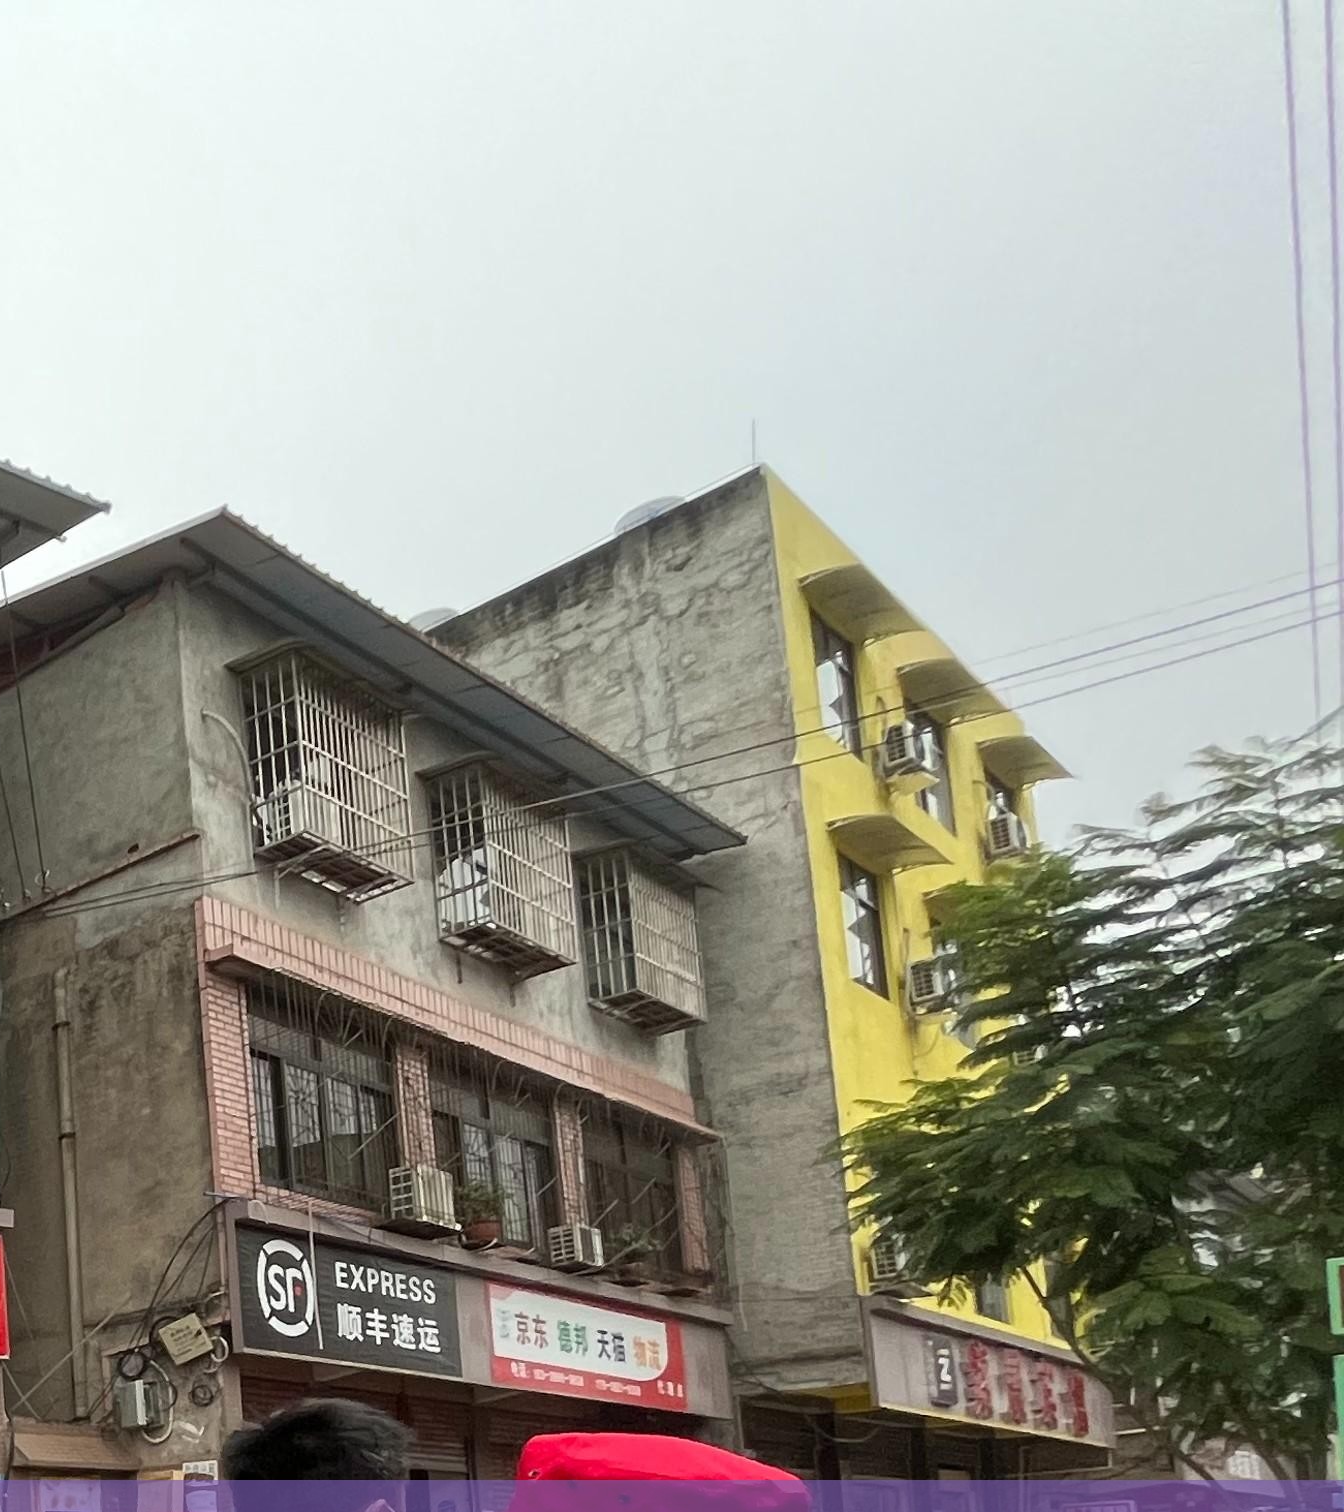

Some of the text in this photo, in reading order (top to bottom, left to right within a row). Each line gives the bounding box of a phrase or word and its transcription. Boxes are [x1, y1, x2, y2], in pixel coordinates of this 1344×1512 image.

[334, 1261, 437, 1304] EXPRESS
[336, 1302, 441, 1353] 顺丰速运
